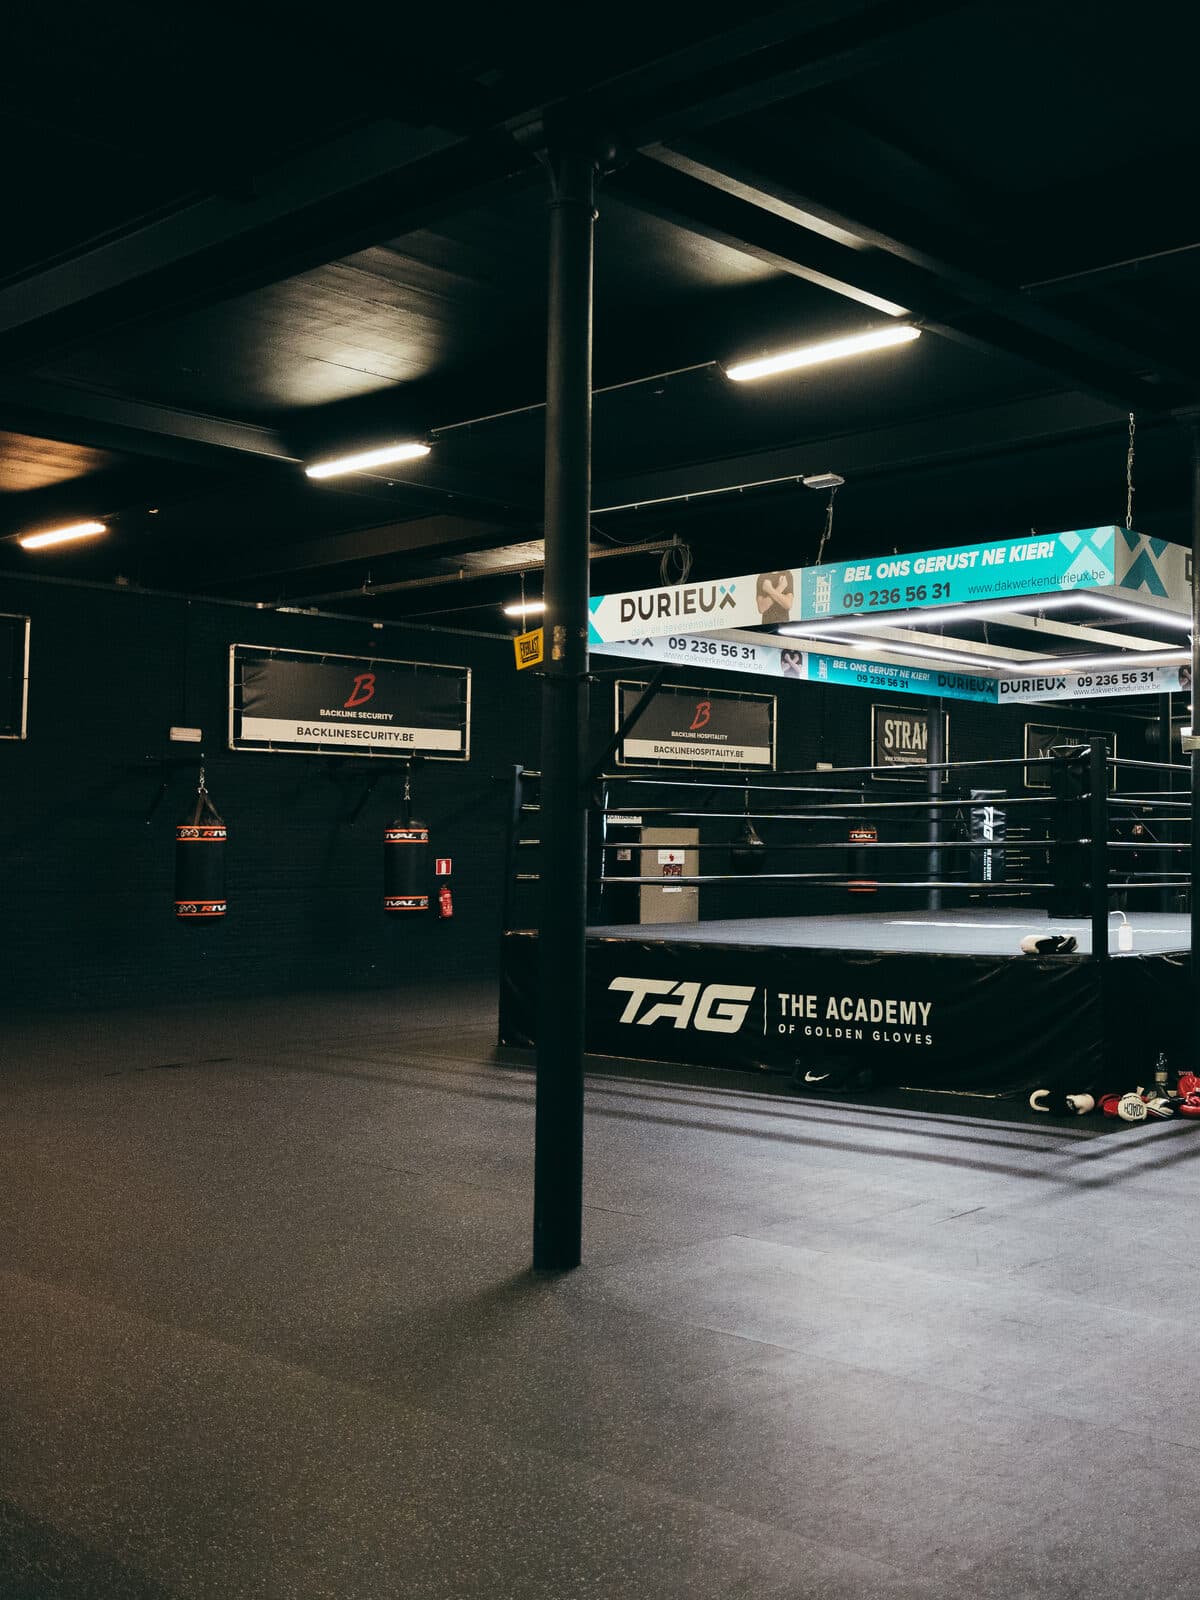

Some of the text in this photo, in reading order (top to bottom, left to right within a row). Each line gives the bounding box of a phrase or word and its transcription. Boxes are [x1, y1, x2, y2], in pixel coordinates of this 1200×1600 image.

[843, 540, 1056, 584] BEL ONS GERUST NE KIER!
[967, 568, 1106, 595] www.dakwerkendurieux.be
[620, 583, 737, 623] DURIEUX
[843, 581, 951, 609] 09 236 56 31
[668, 636, 687, 650] 09
[691, 640, 717, 655] 236
[721, 643, 738, 658] 56
[741, 646, 756, 660] 31
[832, 659, 930, 682] BEL ONS GERUST NE KIER!
[856, 673, 909, 689] 09 236 56 31
[1077, 671, 1155, 688] 09 236 56 31
[937, 674, 995, 693] DURIEUX
[1000, 676, 1066, 695] DURIEUX
[319, 708, 394, 721] BACKLINE SECURITY
[296, 726, 415, 743] BACKLINESECURITY.BE
[671, 730, 729, 741] BACKLINE HOSPITALITY
[653, 745, 745, 758] BACKLINEHOSPITALITY.BE
[608, 976, 757, 1034] TAG
[778, 992, 933, 1027] THE ACADEMY
[778, 1023, 933, 1046] OF GOLDEN GLOVES
